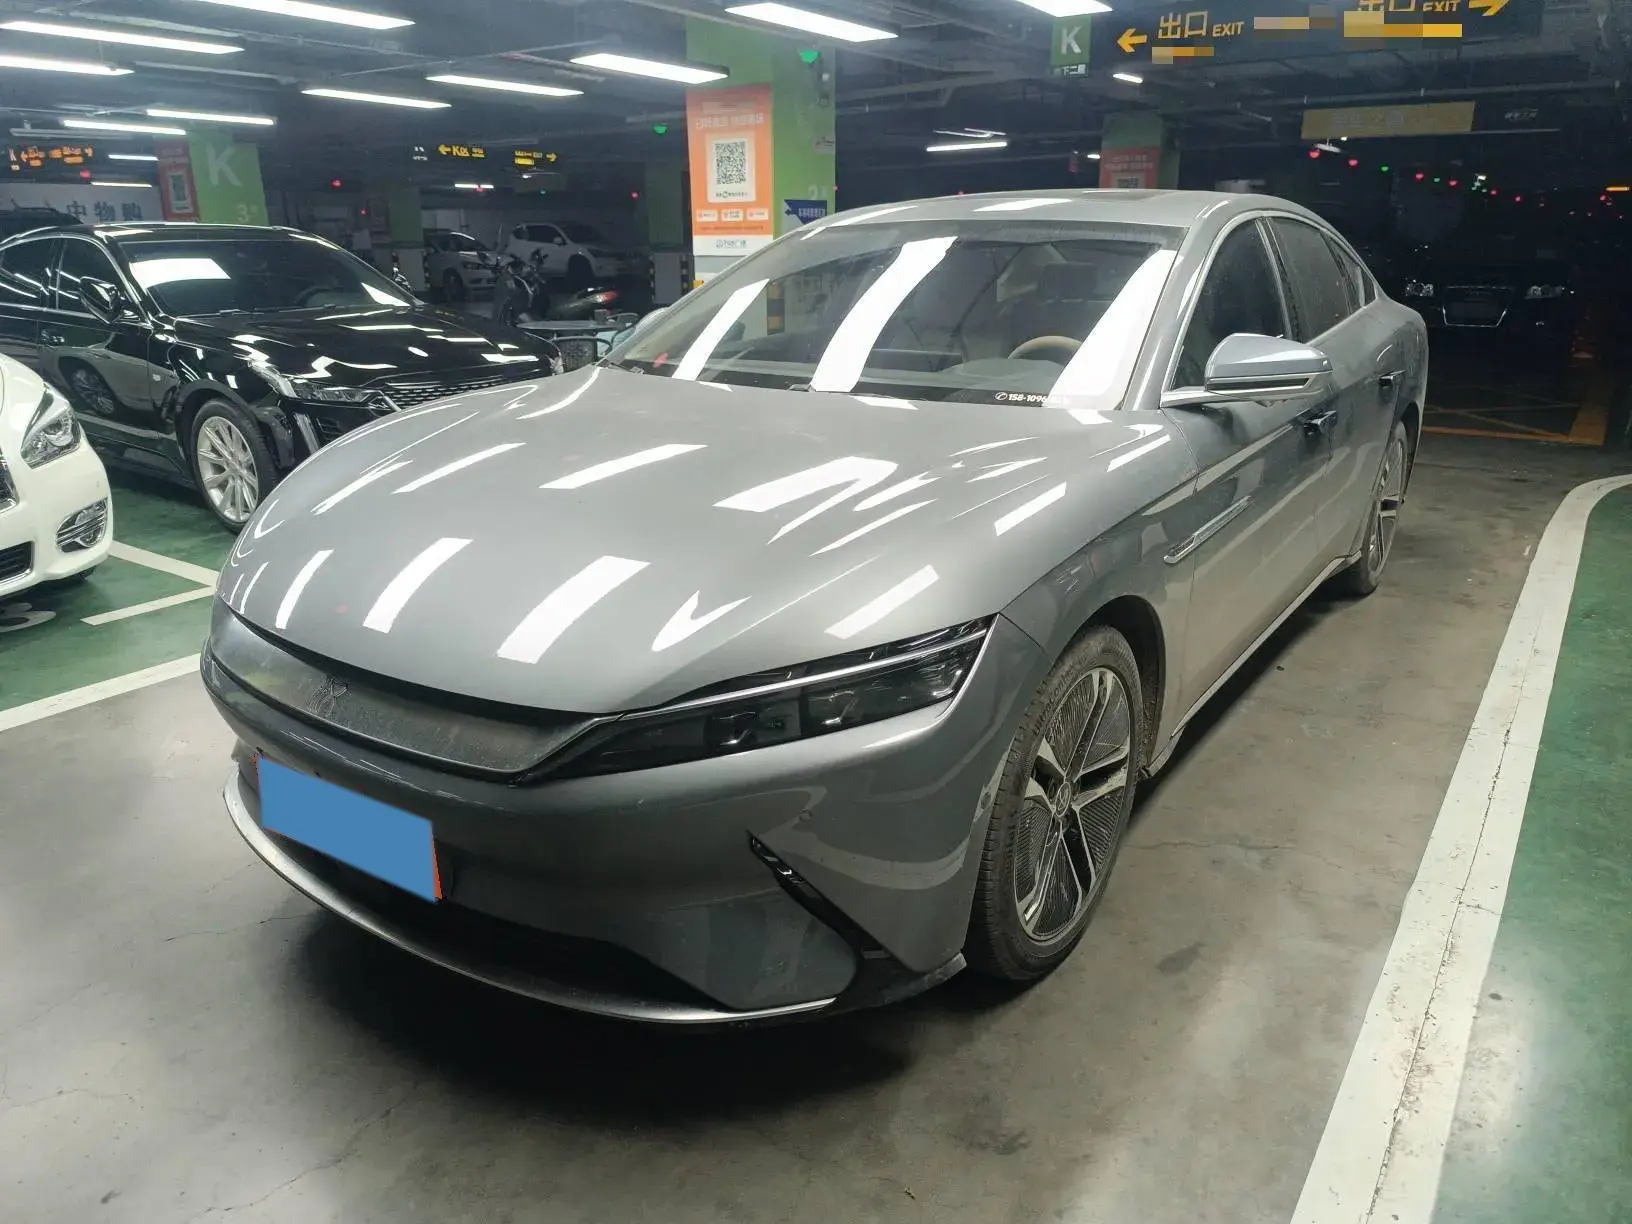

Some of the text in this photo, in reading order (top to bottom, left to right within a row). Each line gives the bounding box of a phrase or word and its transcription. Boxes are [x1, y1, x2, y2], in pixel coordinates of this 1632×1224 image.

[1158, 11, 1245, 39] 出口 EXIT
[1061, 26, 1082, 55] K
[206, 143, 242, 187] K
